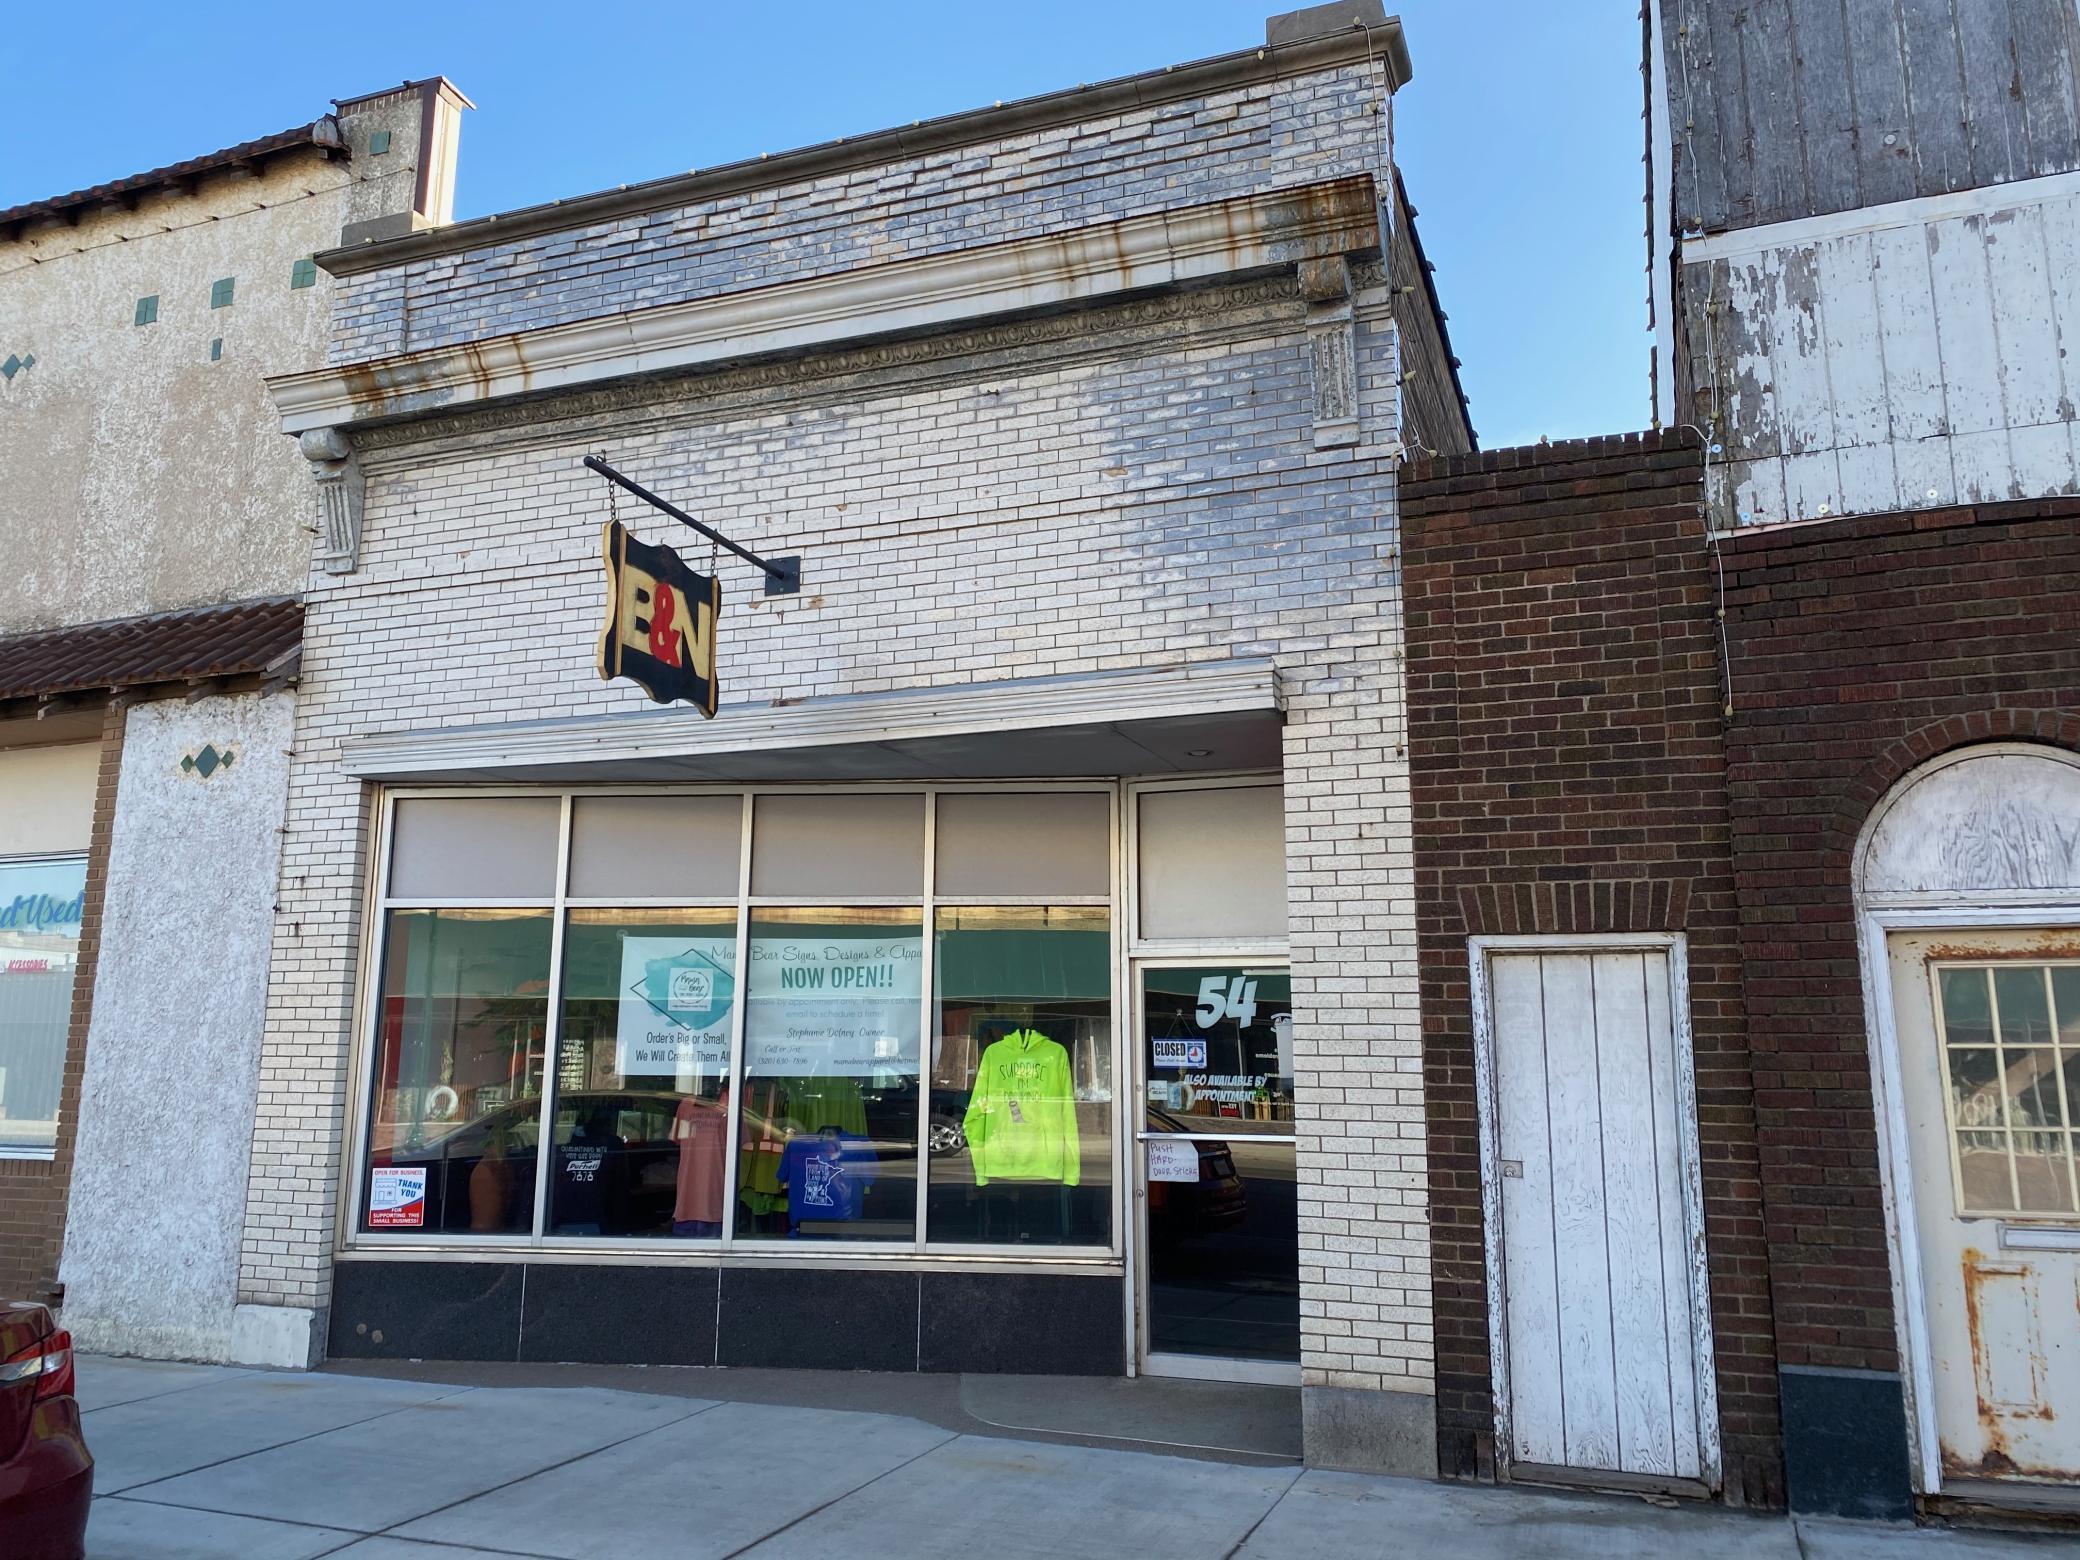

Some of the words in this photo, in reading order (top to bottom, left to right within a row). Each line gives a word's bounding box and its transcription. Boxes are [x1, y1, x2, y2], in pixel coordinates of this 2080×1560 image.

[621, 564, 711, 681] B&N
[20, 889, 85, 930] Used
[751, 945, 778, 960] Bear
[824, 946, 869, 963] Designs
[874, 946, 885, 958] &
[782, 967, 824, 988] NOW
[831, 964, 894, 988] OPEN!!
[1195, 975, 1259, 1029] 54
[785, 1010, 808, 1018] email
[810, 1010, 817, 1018] to
[819, 1010, 856, 1018] schedule
[646, 1032, 675, 1043] Order's
[677, 1033, 690, 1045] Big
[692, 1034, 701, 1043] or
[703, 1033, 727, 1045] Small,
[636, 1050, 648, 1061] We
[651, 1050, 665, 1061] Will
[668, 1050, 694, 1061] Create
[697, 1051, 718, 1062] Them
[1155, 1042, 1186, 1057] CLOSED
[999, 1061, 1048, 1081] SURPRISE
[1183, 1073, 1206, 1086] ALSO
[1207, 1074, 1253, 1087] AVAILABLE
[1254, 1075, 1267, 1087] BY
[1194, 1088, 1257, 1101] APPOINTMENT
[1150, 1142, 1173, 1153] PUSH
[398, 1179, 423, 1190] THANK
[400, 1189, 416, 1198] YOU
